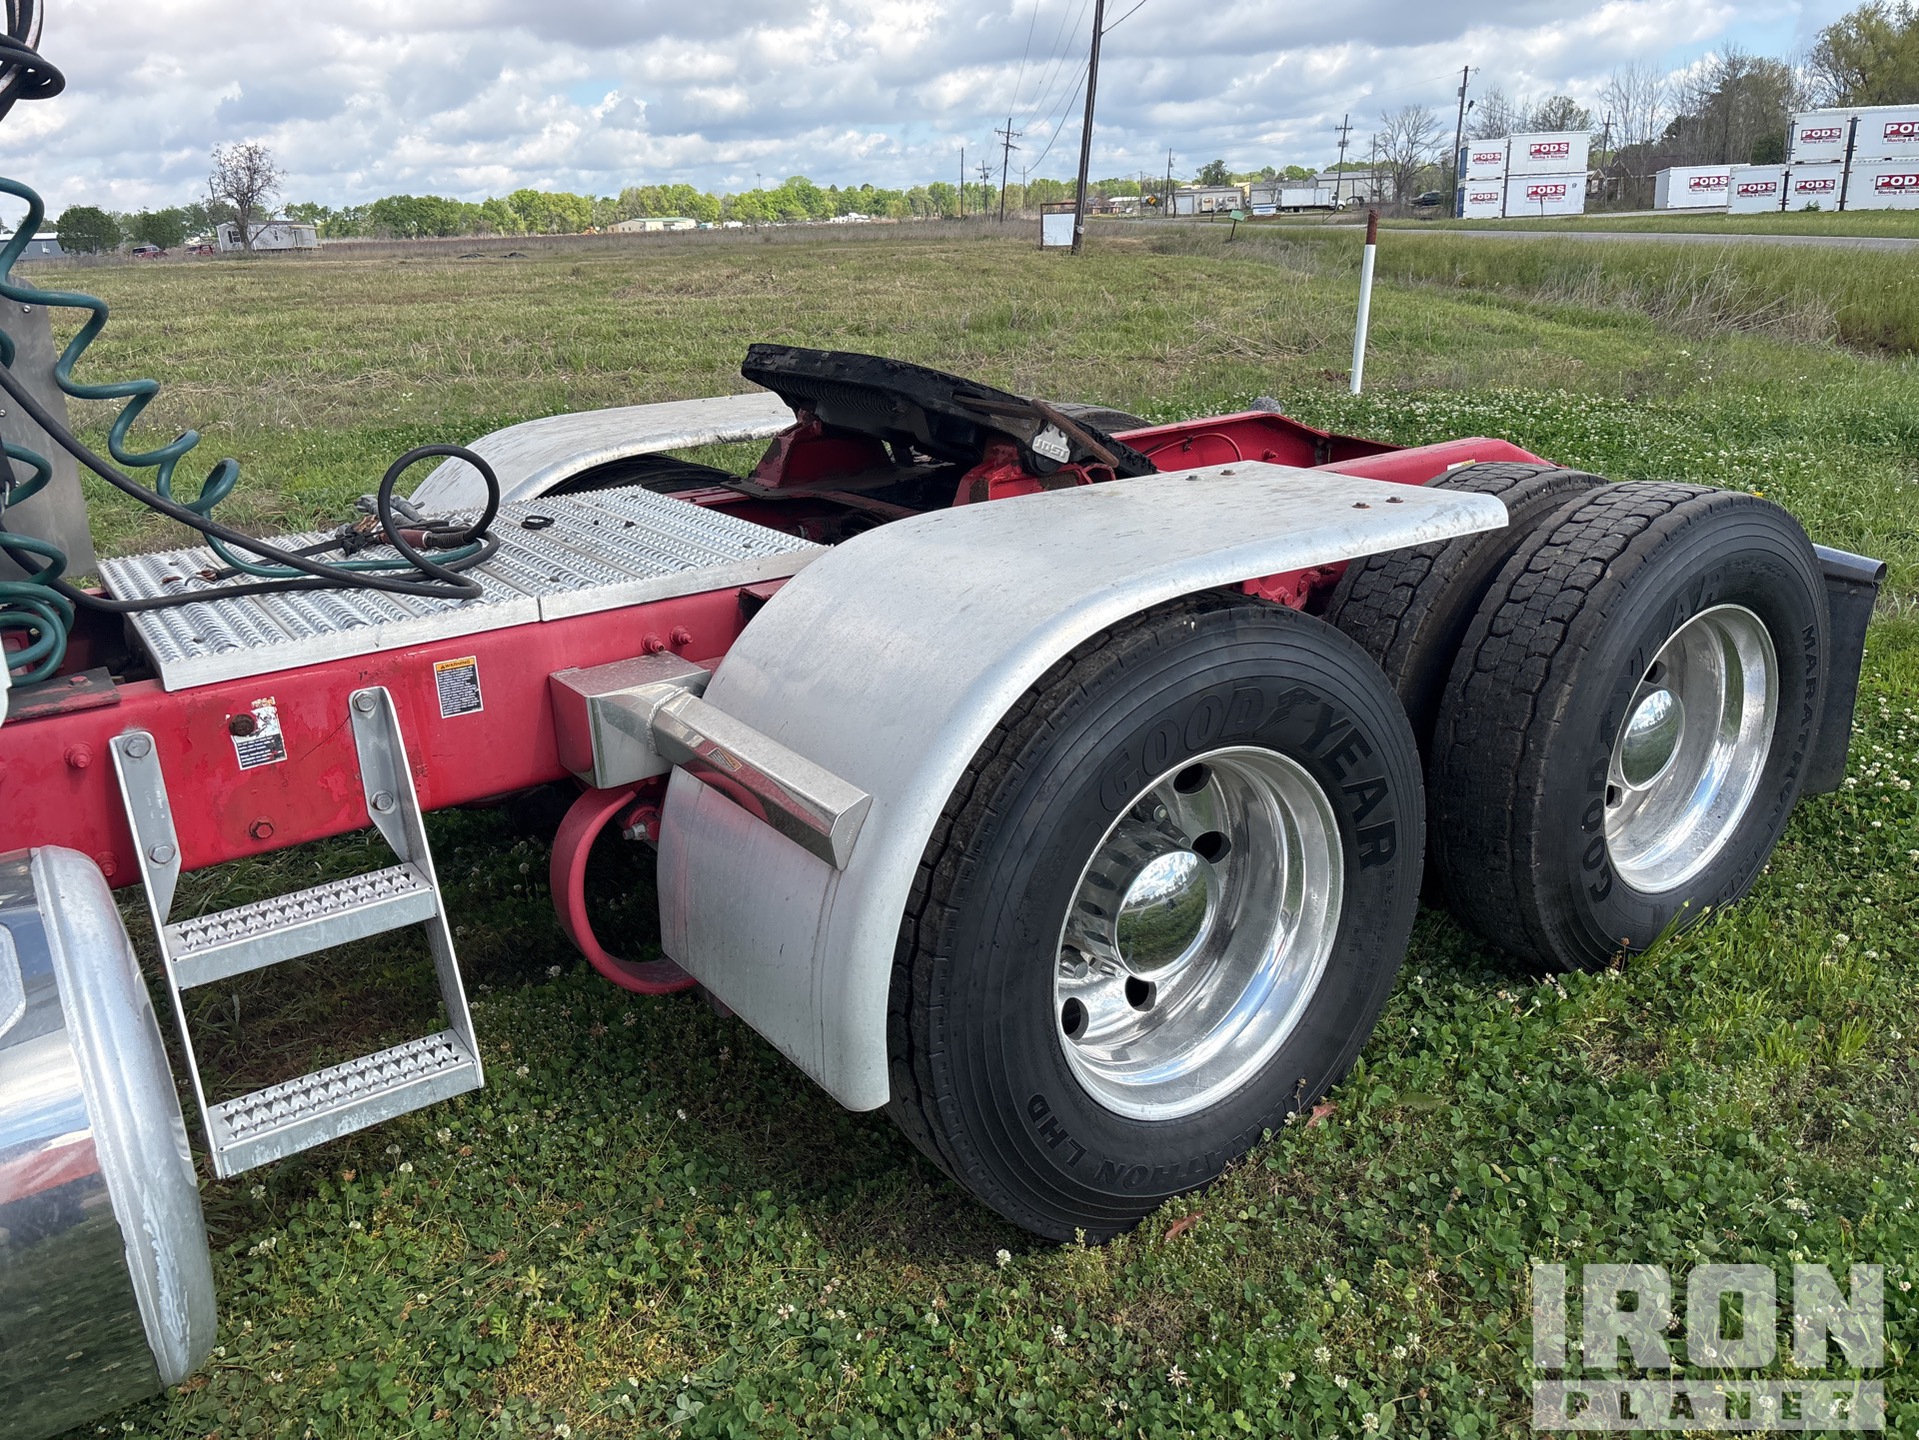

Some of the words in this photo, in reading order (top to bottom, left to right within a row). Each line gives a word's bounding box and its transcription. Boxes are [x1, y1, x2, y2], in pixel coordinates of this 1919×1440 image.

[1801, 129, 1840, 138] PODS
[1530, 143, 1568, 153] PODS
[1690, 176, 1728, 186] PODS
[1796, 180, 1834, 189] PODS
[1876, 175, 1919, 186] POD
[1528, 185, 1565, 195] PODS
[1738, 183, 1776, 192] PODS
[1033, 439, 1069, 459] JOST
[1026, 1092, 1088, 1168] LHD
